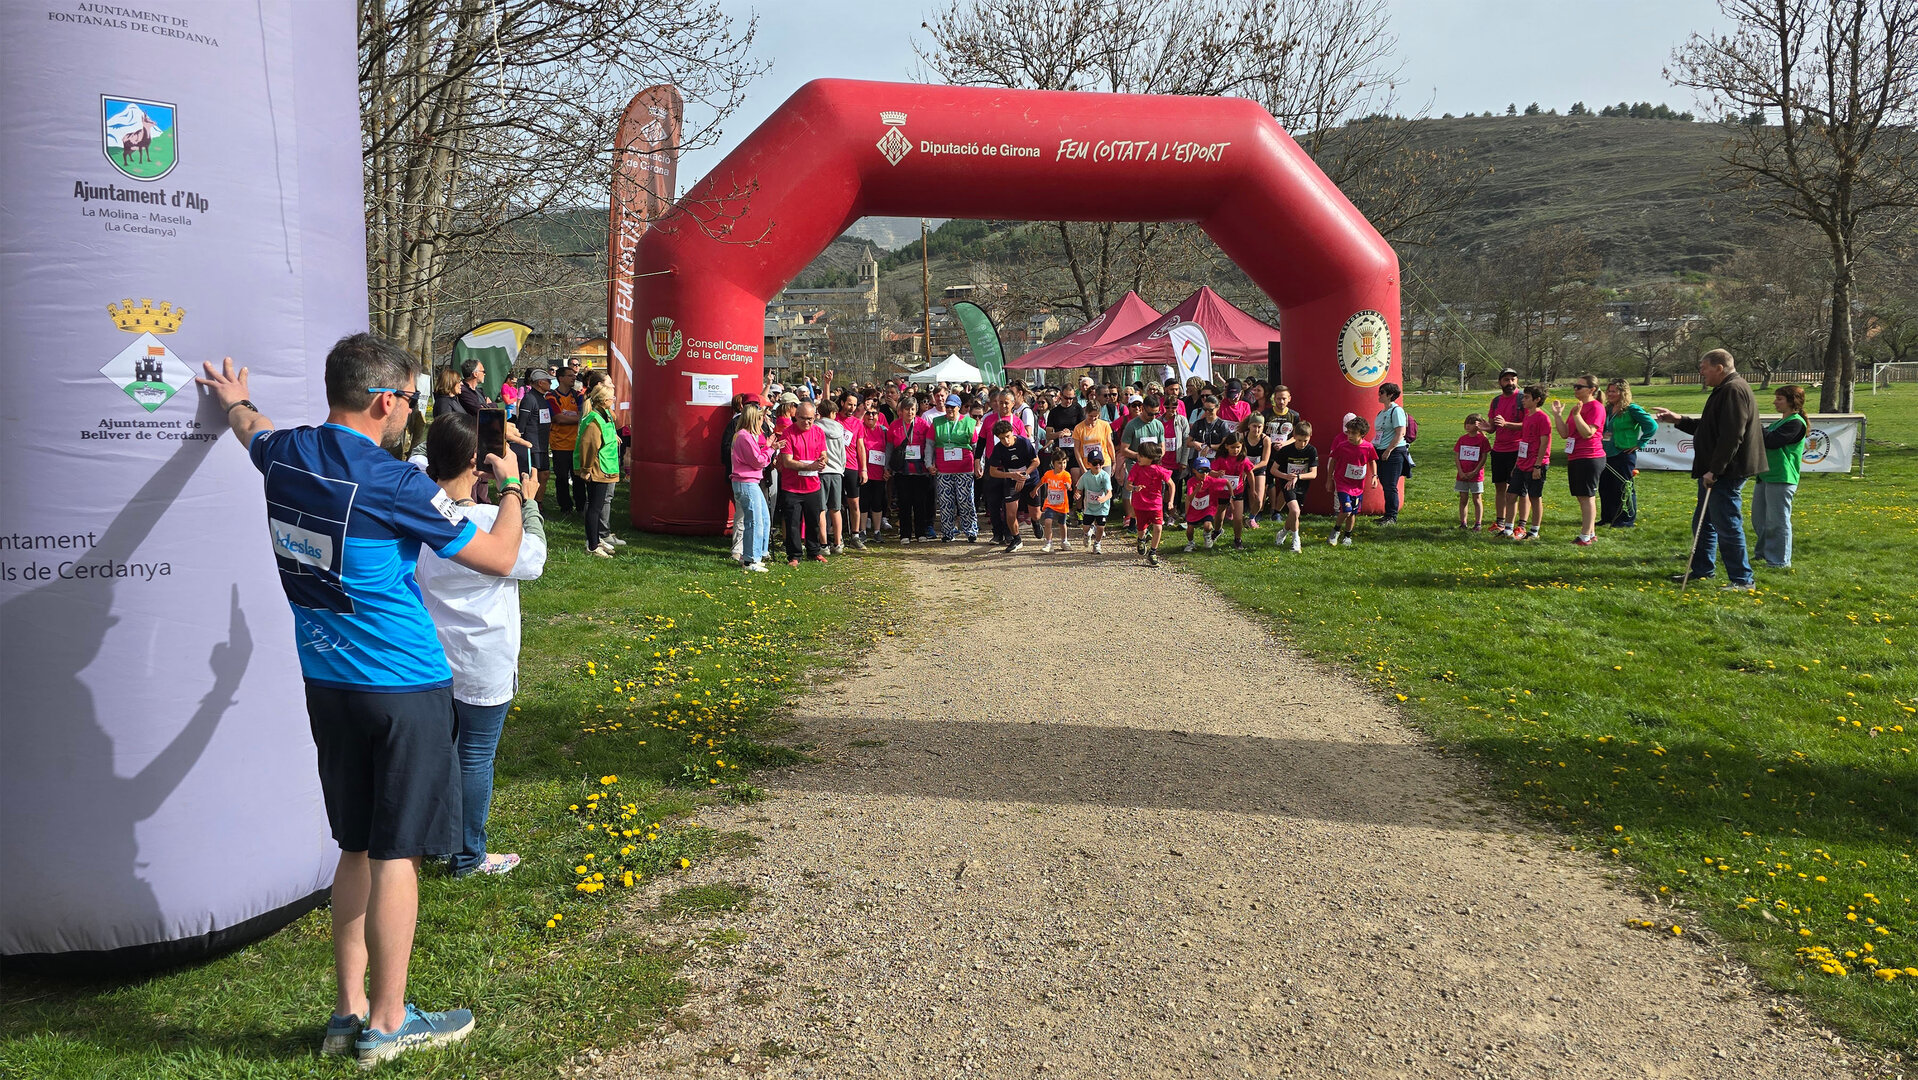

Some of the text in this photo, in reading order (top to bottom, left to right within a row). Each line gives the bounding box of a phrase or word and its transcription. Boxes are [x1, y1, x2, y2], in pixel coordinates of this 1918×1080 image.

[78, 2, 189, 28] AJUNTAMENT DE
[48, 12, 219, 47] FONTANALS DE CERDANYA
[920, 140, 1040, 157] Diputació de Girona
[1055, 139, 1231, 163] FEM COSTAT A L'ESPORT
[626, 159, 638, 168] de
[74, 180, 209, 213] Ajuntament d'Alp
[82, 207, 96, 217] La
[99, 208, 139, 220] Molina
[149, 212, 192, 226] Masella
[104, 222, 177, 237] (La Cerdanya)
[615, 279, 634, 324] FEM
[687, 337, 758, 353] Consell Comarcal
[686, 349, 753, 364] de la Cerdanya
[98, 418, 201, 430] Ajuntament de
[80, 430, 219, 442] Bellver de Cerdanya
[0, 532, 97, 550] ntament
[1, 560, 171, 582] ls de Cerdanya
